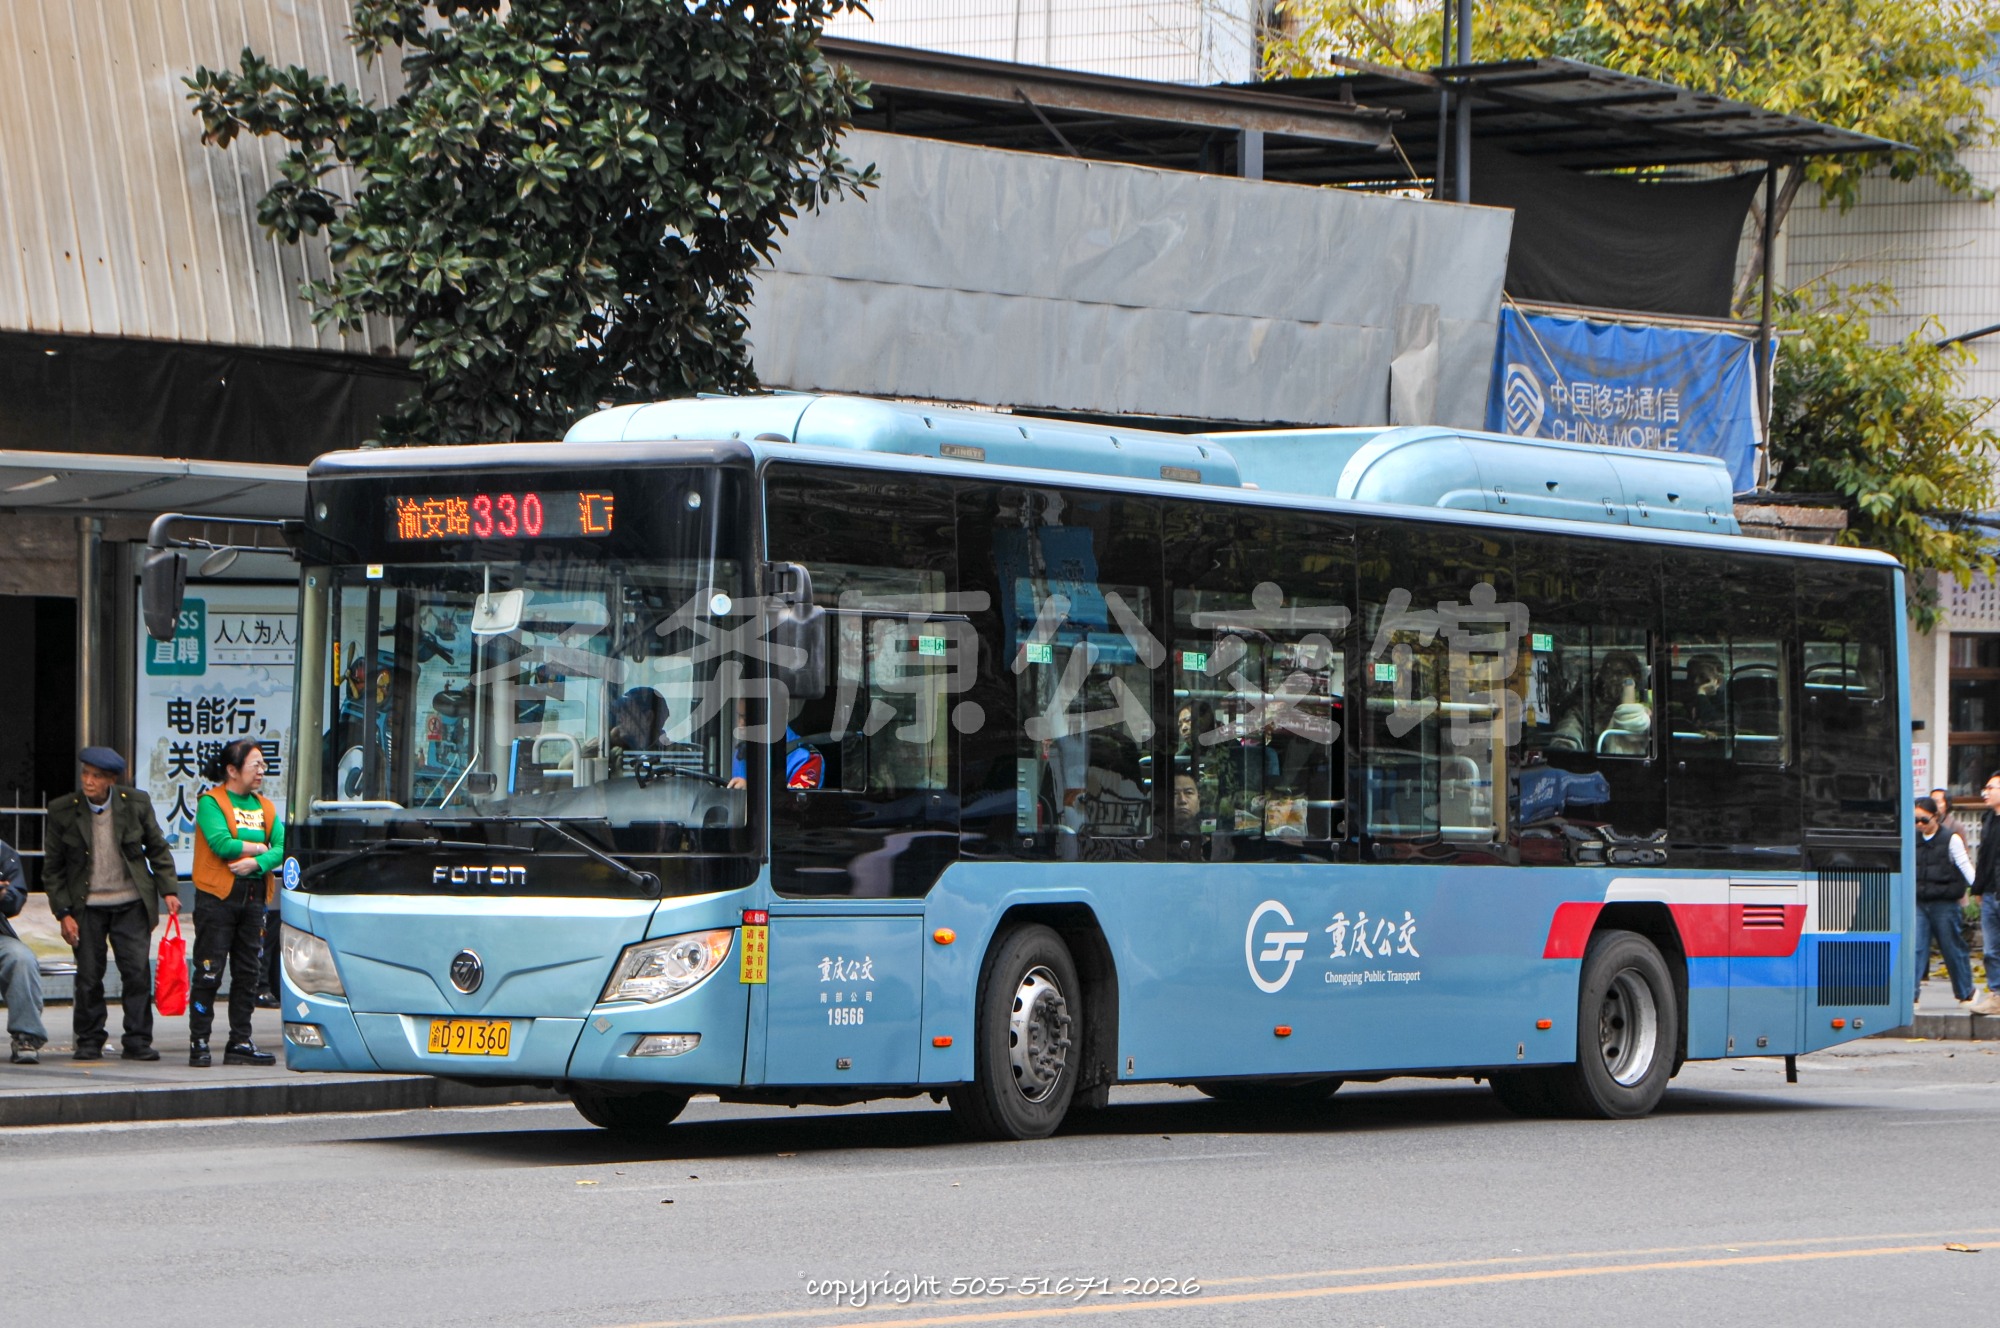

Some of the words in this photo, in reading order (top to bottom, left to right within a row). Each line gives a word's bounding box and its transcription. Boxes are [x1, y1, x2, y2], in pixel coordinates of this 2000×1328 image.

[1550, 379, 1679, 422] 中国移动通信
[1552, 418, 1608, 446] CHINA
[1613, 426, 1679, 451] MOBILE
[397, 497, 470, 538] 渝安路
[473, 493, 543, 536] 330
[214, 619, 297, 645] 人人为人
[153, 637, 199, 664] 直聘
[433, 866, 526, 885] FOTON
[1325, 911, 1420, 959] 重庆公交
[817, 955, 875, 982] 重庆公交
[1325, 971, 1363, 985] Chongqing
[1364, 970, 1385, 982] Public
[1387, 970, 1420, 984] Transport
[828, 1007, 864, 1026] 19566
